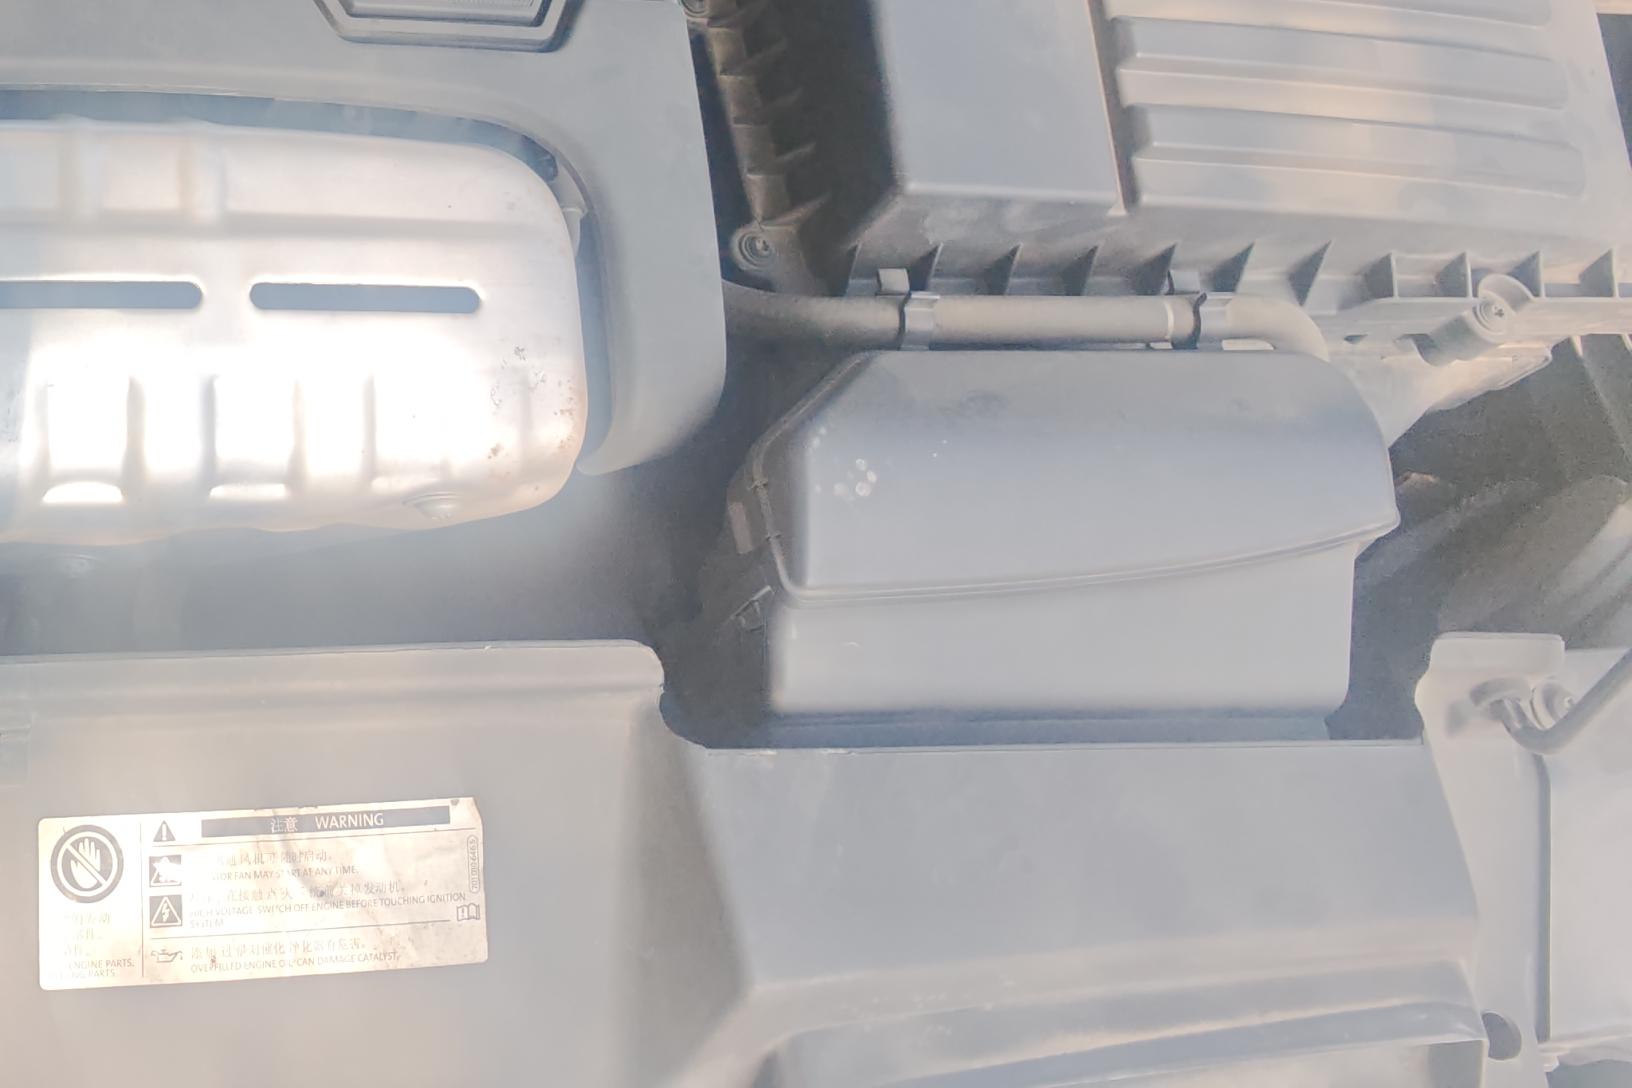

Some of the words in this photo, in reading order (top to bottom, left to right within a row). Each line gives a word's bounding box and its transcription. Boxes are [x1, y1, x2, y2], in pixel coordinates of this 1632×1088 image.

[269, 815, 299, 834] 注意
[315, 813, 385, 830] WARNING
[234, 871, 252, 881] FAN
[253, 869, 273, 880] MAY
[275, 868, 300, 880] SRT
[313, 867, 333, 877] ANY
[257, 904, 292, 914] SWITCH
[293, 903, 309, 913] OFF
[311, 900, 344, 912] ENGINE
[345, 897, 378, 909] BEFORE
[378, 894, 426, 907] TOUCHING
[426, 892, 467, 903] IGNITION
[190, 960, 241, 973] OVERFILLED
[243, 959, 277, 970] ENGINE
[278, 959, 293, 969] OL
[296, 957, 315, 968] CAN
